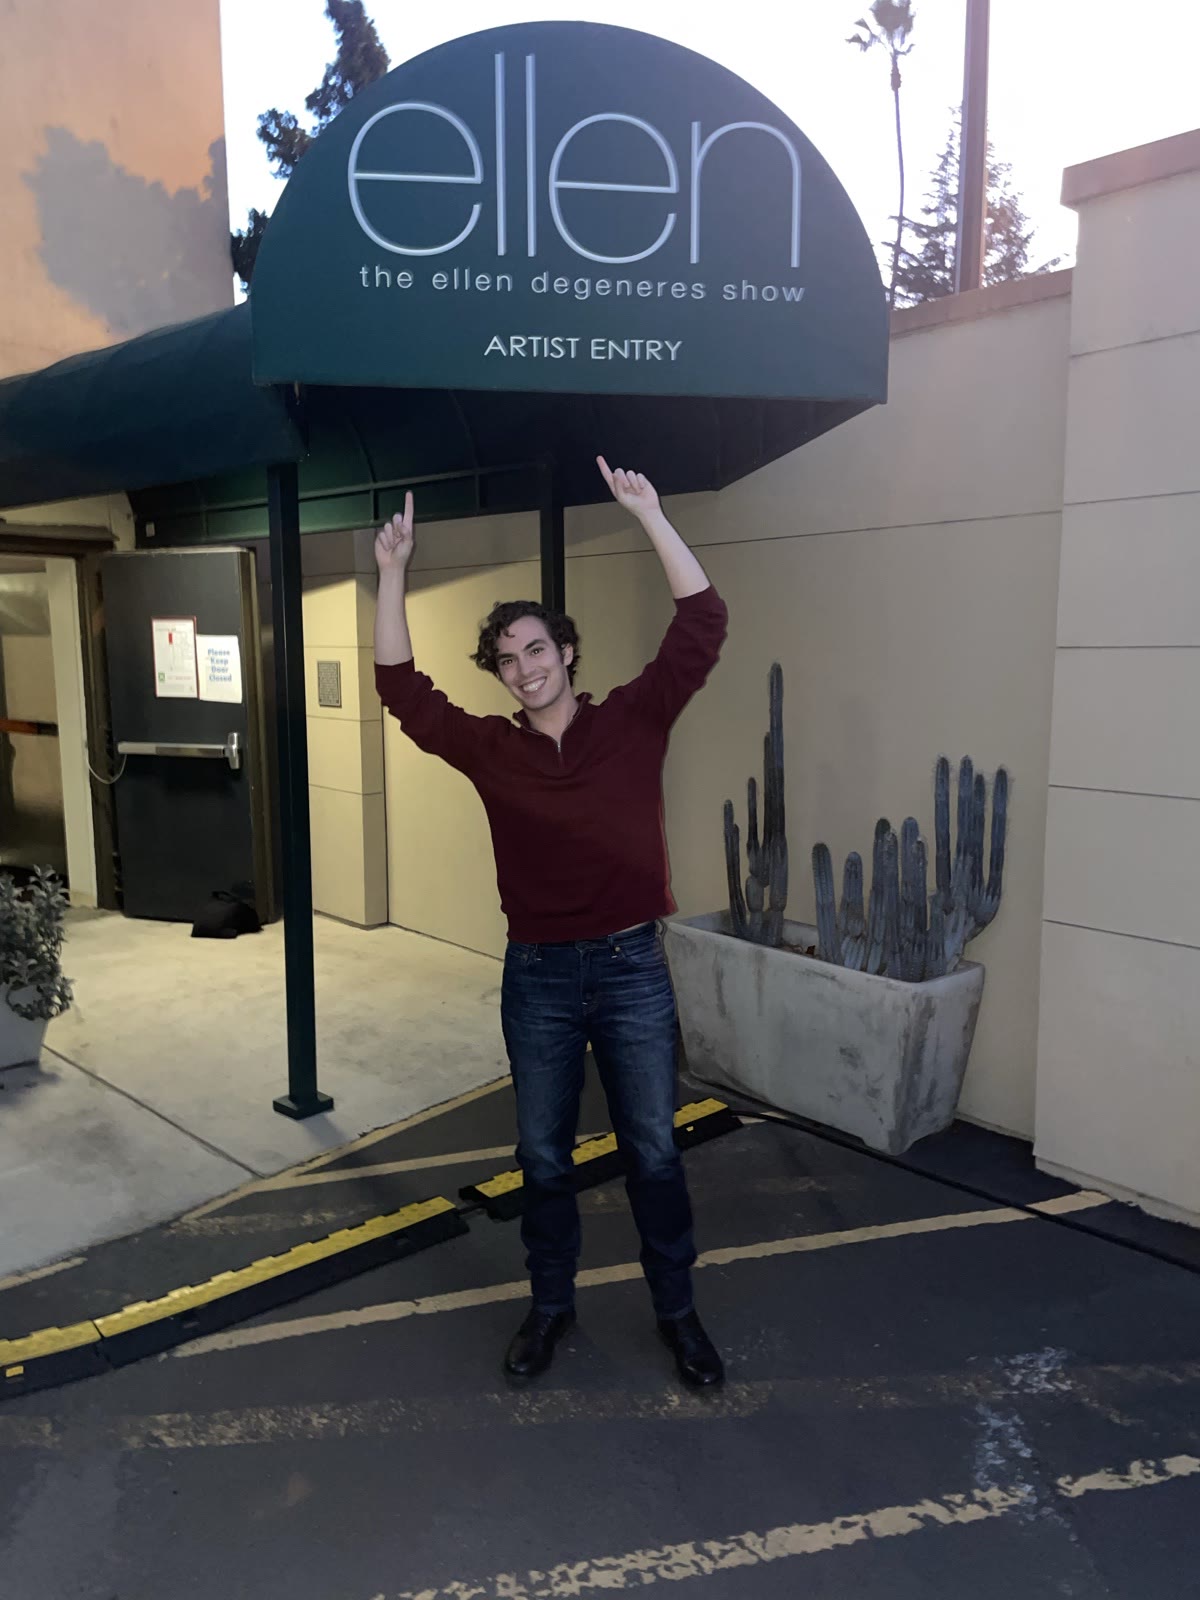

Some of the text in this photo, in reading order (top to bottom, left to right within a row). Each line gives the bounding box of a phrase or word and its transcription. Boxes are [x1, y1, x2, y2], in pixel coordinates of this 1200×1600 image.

[348, 52, 801, 268] ellen
[360, 265, 806, 302] the ellen degeneres show
[484, 335, 683, 361] ARTIST ENTRY
[207, 648, 231, 656] Please
[210, 657, 229, 666] Keep
[211, 666, 229, 674] Door
[209, 674, 232, 682] Closed
